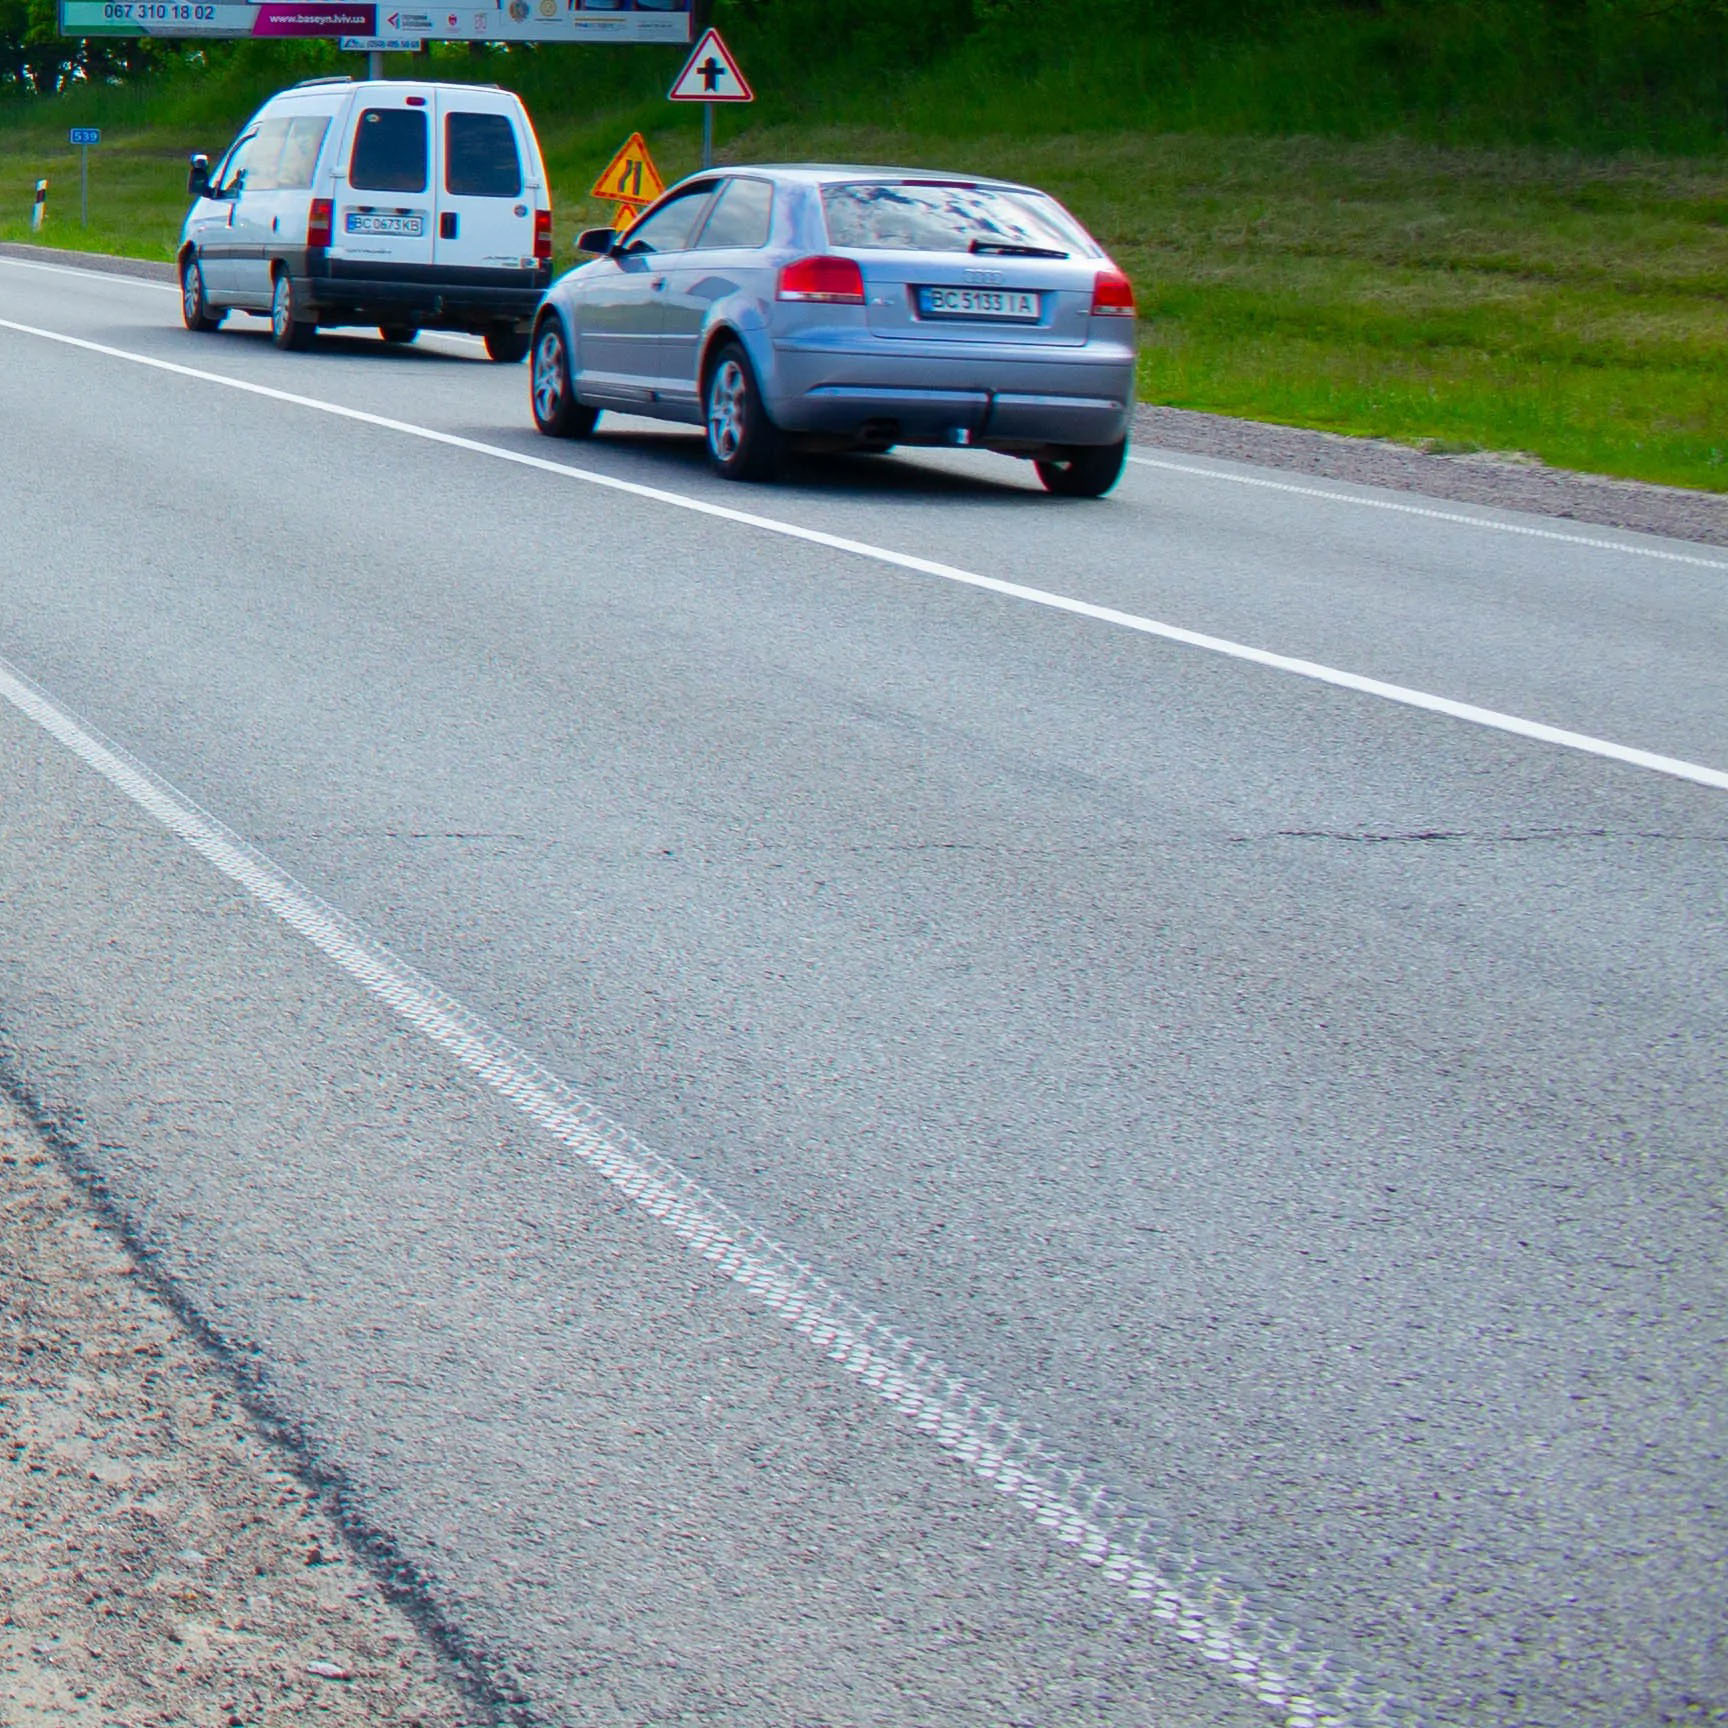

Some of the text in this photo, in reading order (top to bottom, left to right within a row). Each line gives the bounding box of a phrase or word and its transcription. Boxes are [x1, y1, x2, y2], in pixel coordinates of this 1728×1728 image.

[104, 4, 214, 20] 067 310 18 02
[269, 14, 366, 25] www.baseyn.lviv.ua
[74, 131, 97, 141] 539
[931, 291, 957, 309] BC
[962, 292, 1003, 311] 5133
